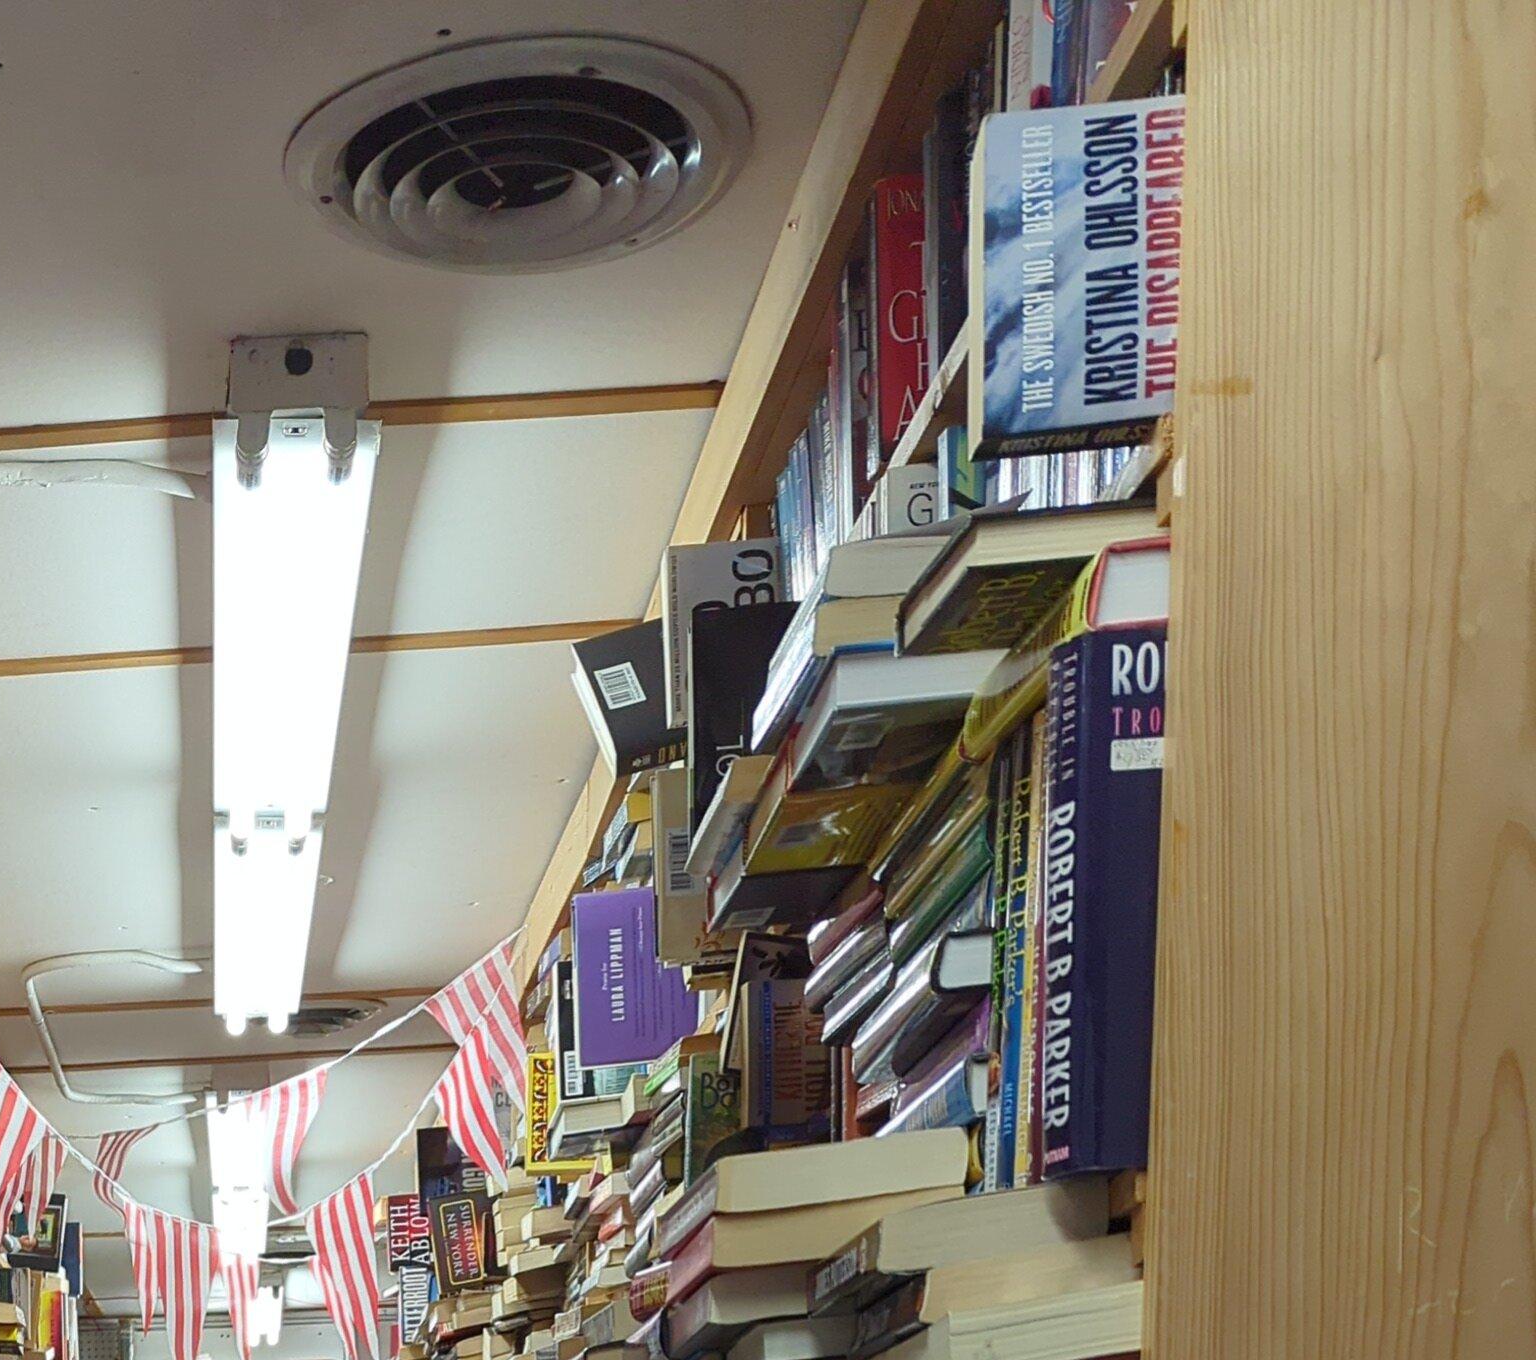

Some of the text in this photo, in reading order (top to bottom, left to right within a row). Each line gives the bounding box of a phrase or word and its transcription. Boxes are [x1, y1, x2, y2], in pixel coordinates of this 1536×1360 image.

[1022, 124, 1054, 236] BESTSELLER
[1022, 255, 1054, 290] NO.
[1083, 113, 1140, 407] KRISTINA OHLSSON
[1022, 292, 1054, 373] SWEDISH
[1022, 381, 1054, 414] THE
[1063, 652, 1079, 754] TROUBLE
[610, 928, 625, 1021] LAURA LIPPMAN
[1043, 800, 1076, 1131] ROBERT B. PARKER
[390, 1205, 410, 1262] KEITH
[410, 1198, 430, 1264] ABLOW
[447, 1214, 464, 1276] NEW YORK
[459, 1205, 478, 1277] SURRENDER
